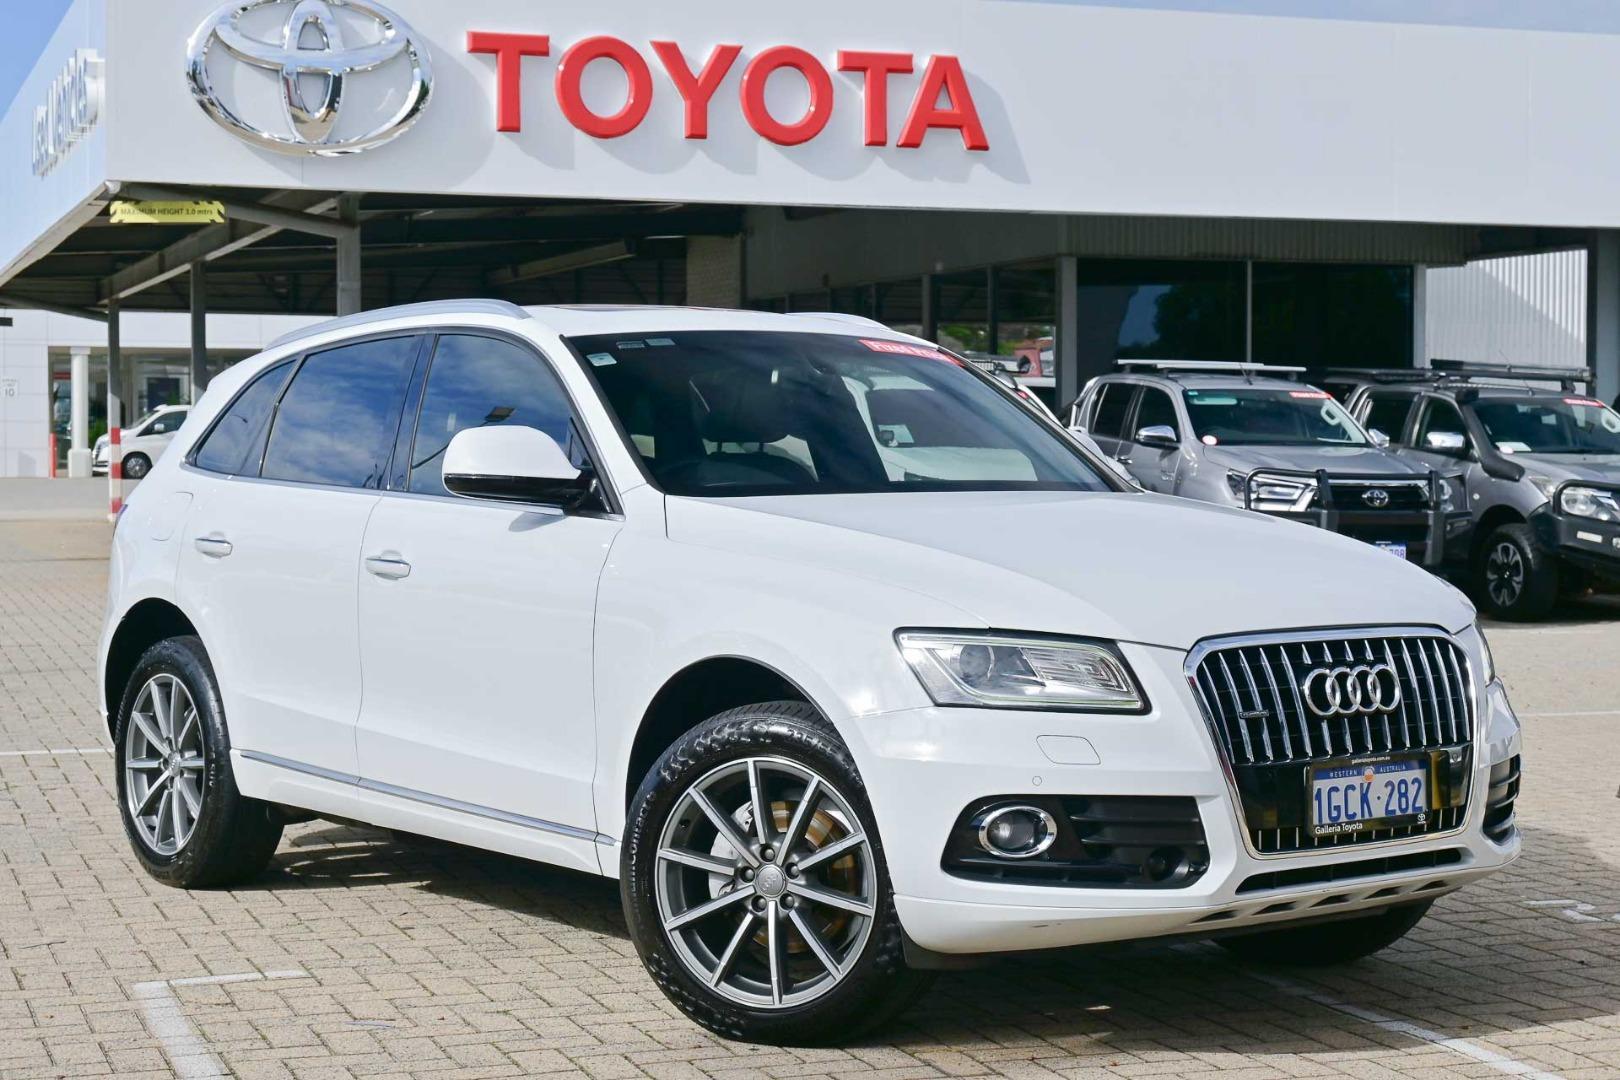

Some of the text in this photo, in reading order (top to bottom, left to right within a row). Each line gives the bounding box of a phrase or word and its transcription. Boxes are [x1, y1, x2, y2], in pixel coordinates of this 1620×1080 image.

[466, 31, 990, 152] TOYOTA
[1329, 764, 1406, 778] WESTERN AUSTRALIA
[1315, 821, 1363, 834] Galleria Toyota
